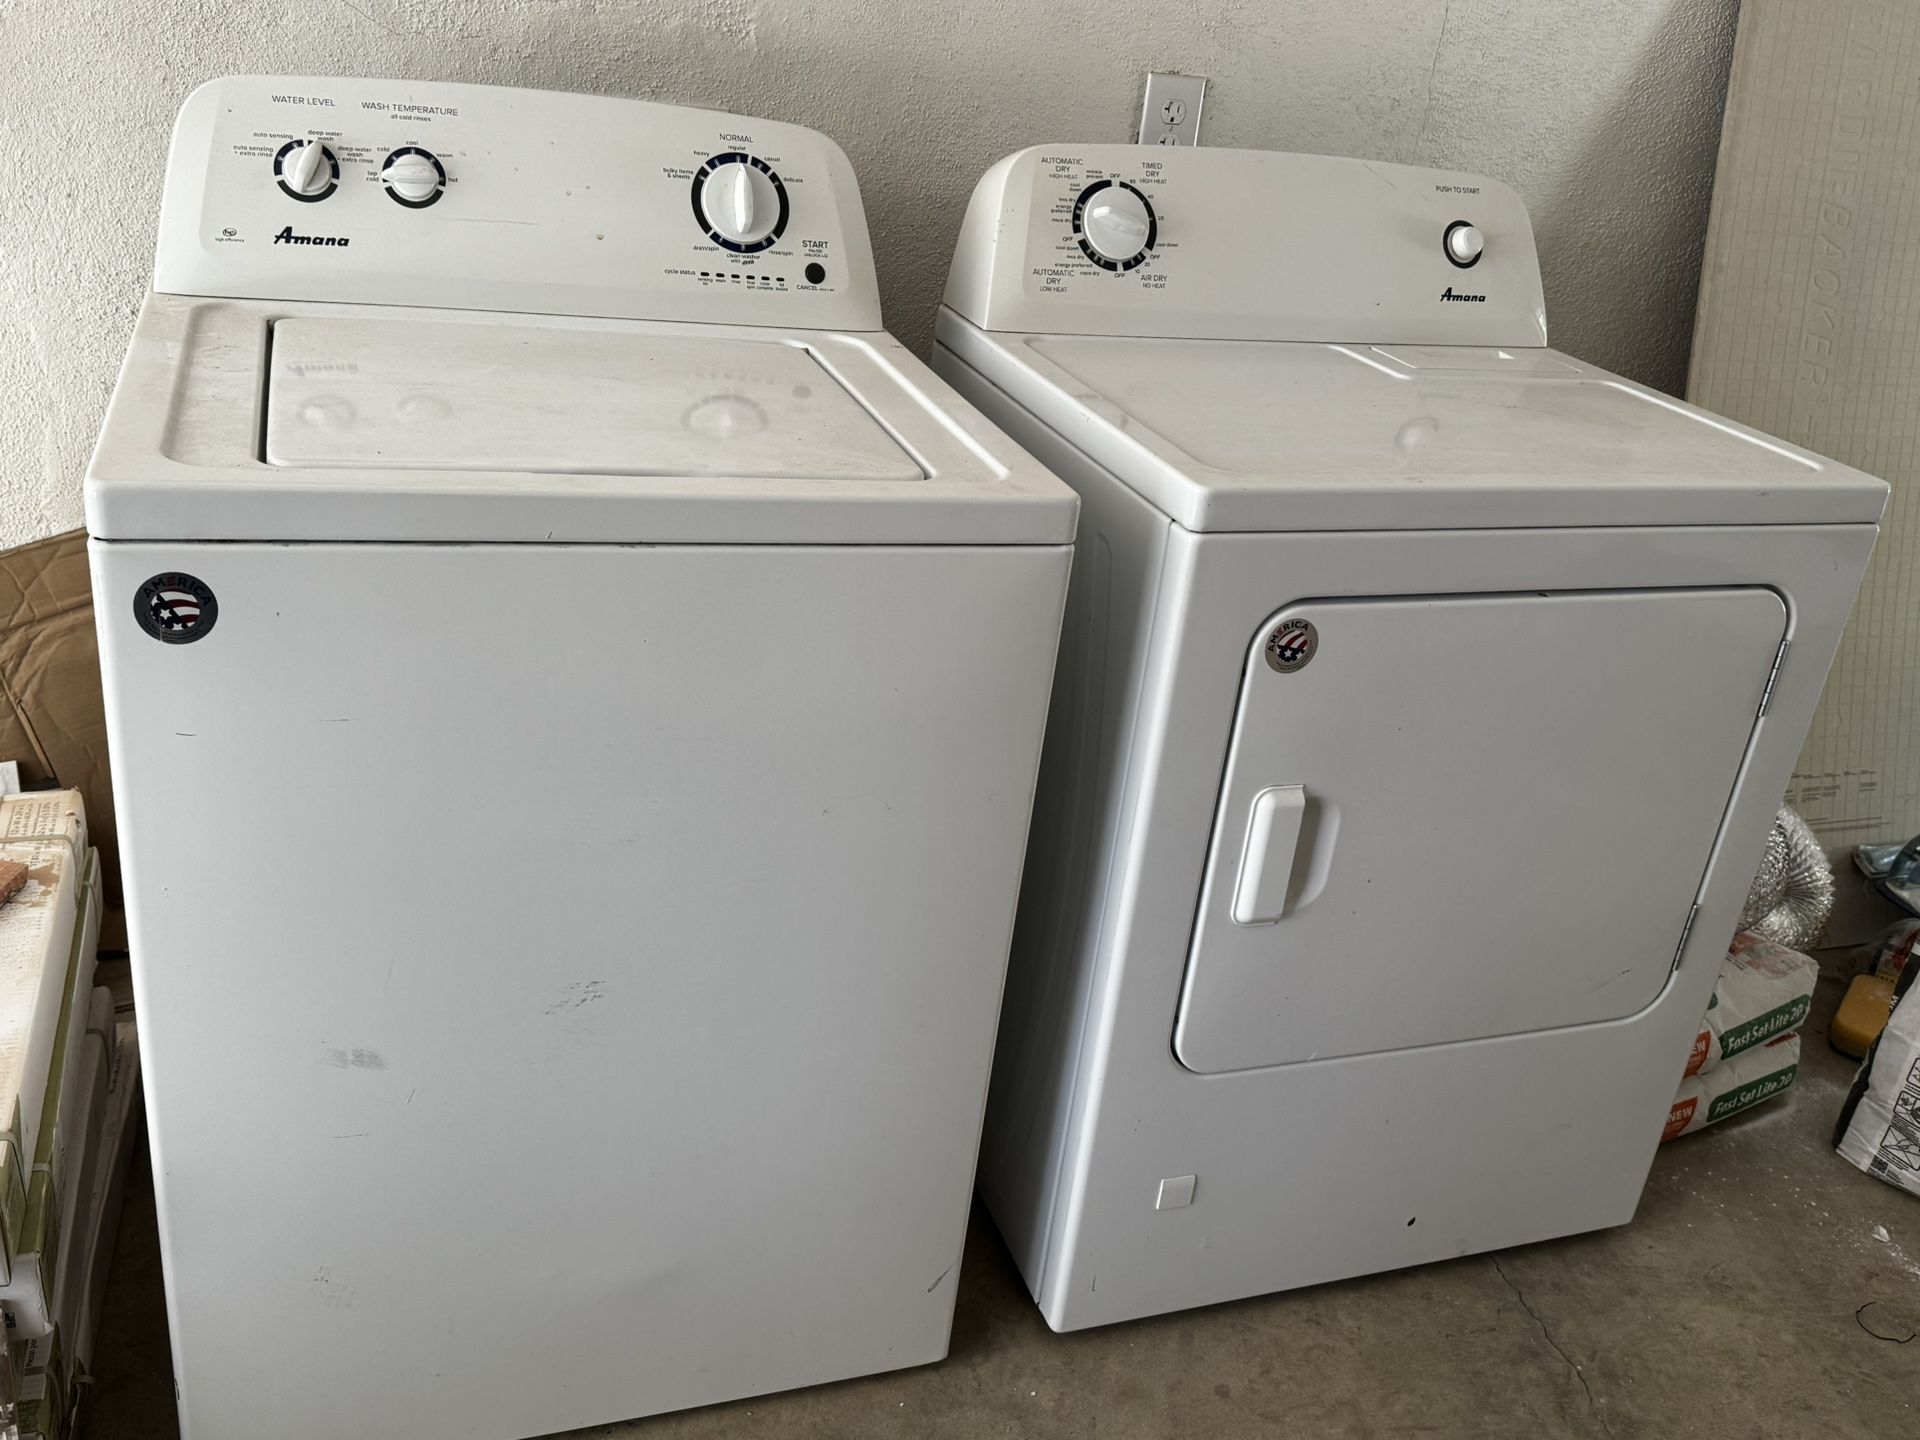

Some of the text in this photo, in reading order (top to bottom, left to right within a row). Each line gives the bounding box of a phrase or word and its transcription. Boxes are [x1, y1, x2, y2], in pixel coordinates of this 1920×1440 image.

[272, 95, 336, 107] WATER LEVEL
[361, 102, 458, 116] WASH TEMPERATURE
[269, 132, 293, 140] sensing
[720, 133, 753, 143] NORMAL
[338, 145, 354, 153] deep
[1041, 157, 1083, 165] AUTOMATIC
[663, 167, 677, 175] bulky
[274, 226, 350, 247] Amana
[802, 240, 828, 249] START
[1033, 268, 1074, 276] AUTOMATIC
[1440, 287, 1486, 302] Amana
[143, 575, 212, 607] AMERICA
[1268, 620, 1309, 652] AMERICA
[1728, 1032, 1750, 1053] Fast
[1752, 1021, 1768, 1041] Set
[1770, 1014, 1790, 1032] Lite
[1714, 1096, 1738, 1116] Fast
[1738, 1089, 1756, 1106] Set
[1756, 1082, 1778, 1098] Lite
[1668, 1105, 1693, 1121] NEW
